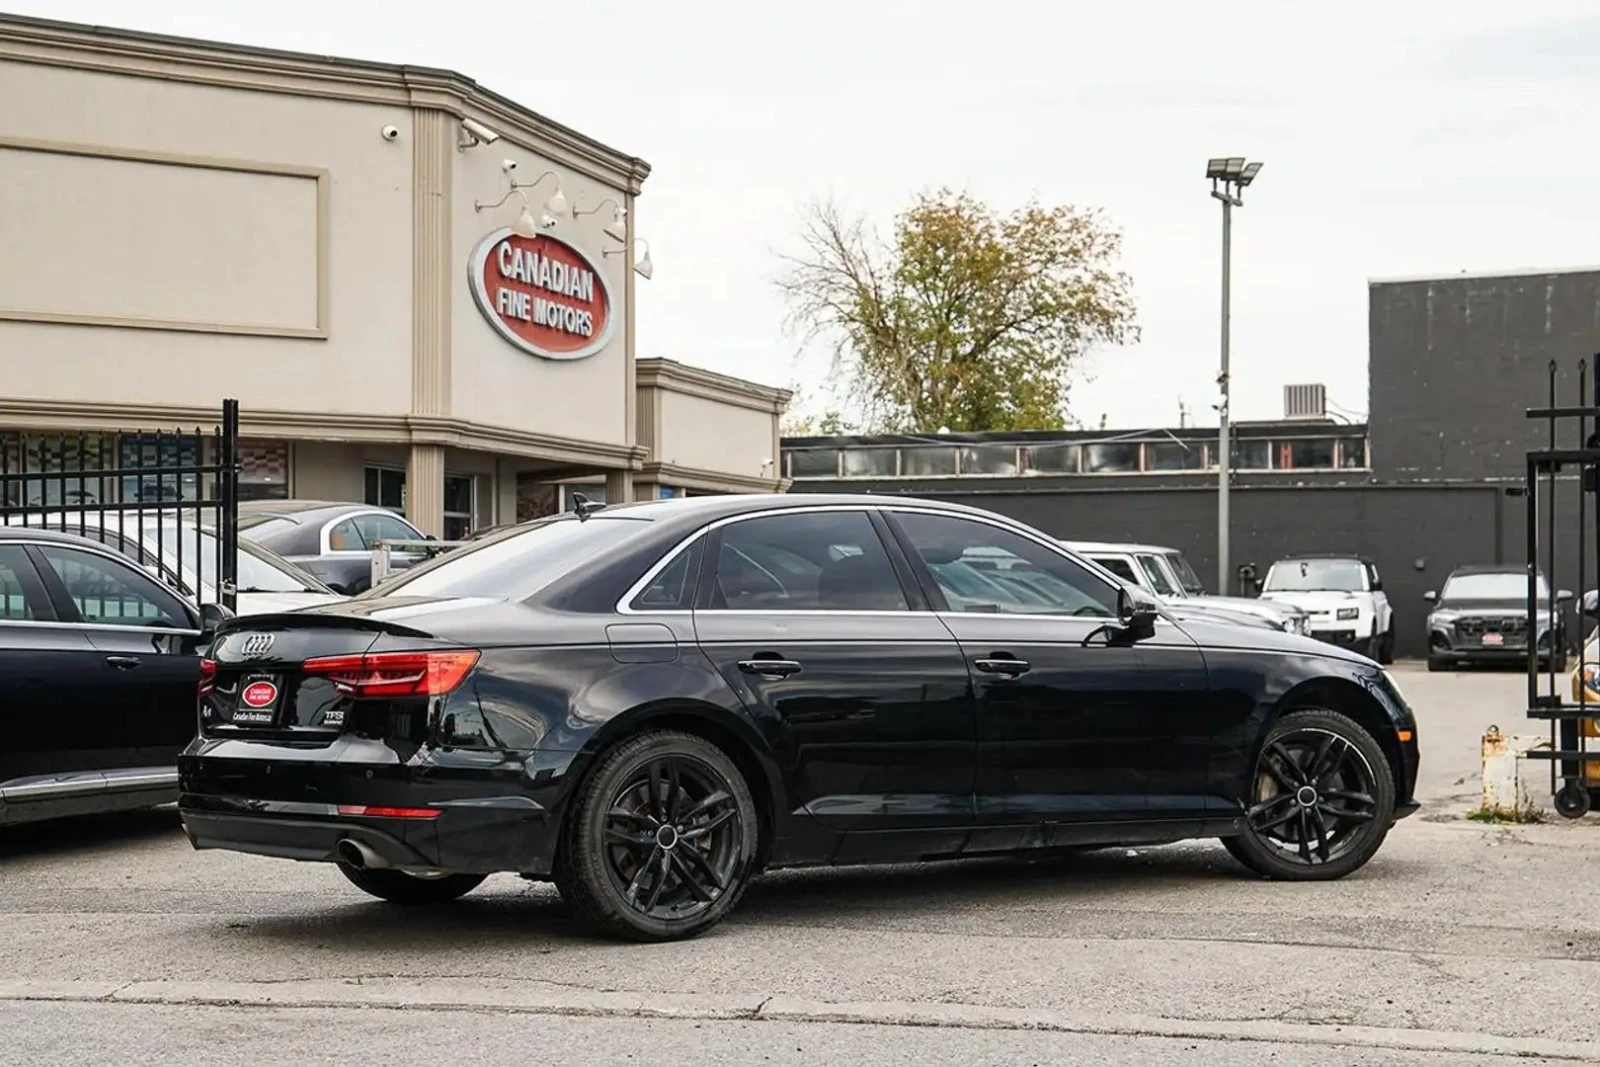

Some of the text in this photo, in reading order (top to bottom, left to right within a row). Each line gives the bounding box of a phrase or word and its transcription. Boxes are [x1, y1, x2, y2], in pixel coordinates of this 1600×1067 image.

[499, 241, 593, 302] CANADIAN
[497, 287, 593, 336] FINE MOTORS
